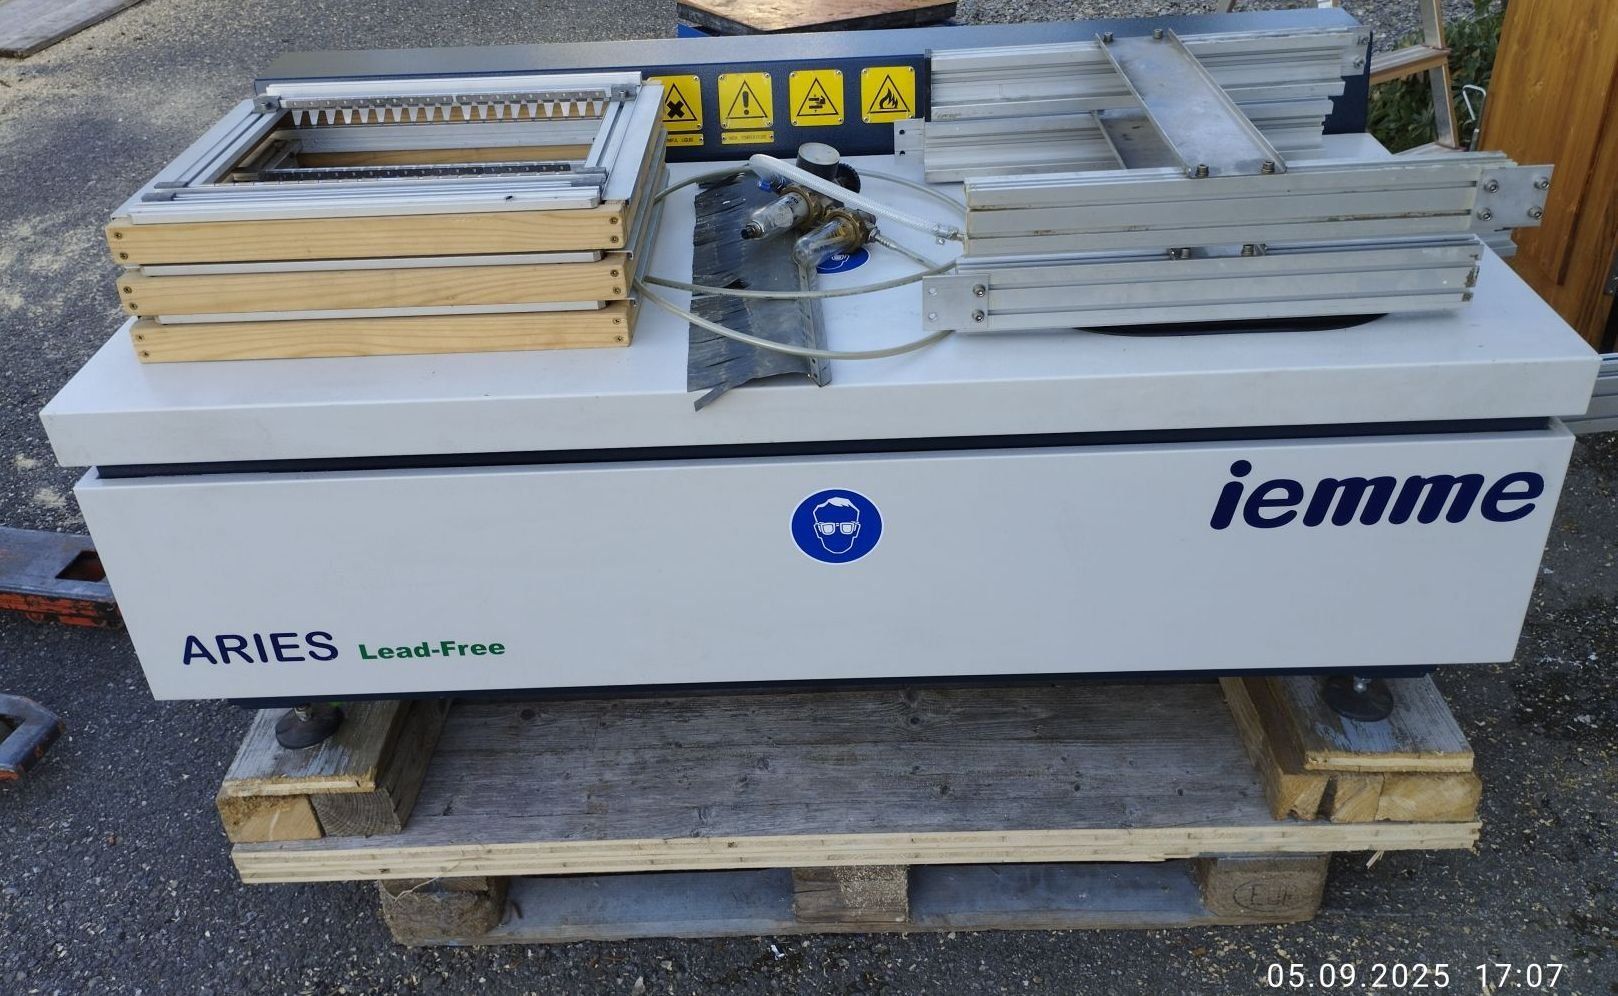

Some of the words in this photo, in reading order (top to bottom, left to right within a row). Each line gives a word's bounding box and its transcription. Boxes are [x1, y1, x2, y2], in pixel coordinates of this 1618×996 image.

[1210, 459, 1544, 530] iemme
[183, 631, 338, 665] ARIES
[359, 640, 505, 660] Lead-Free
